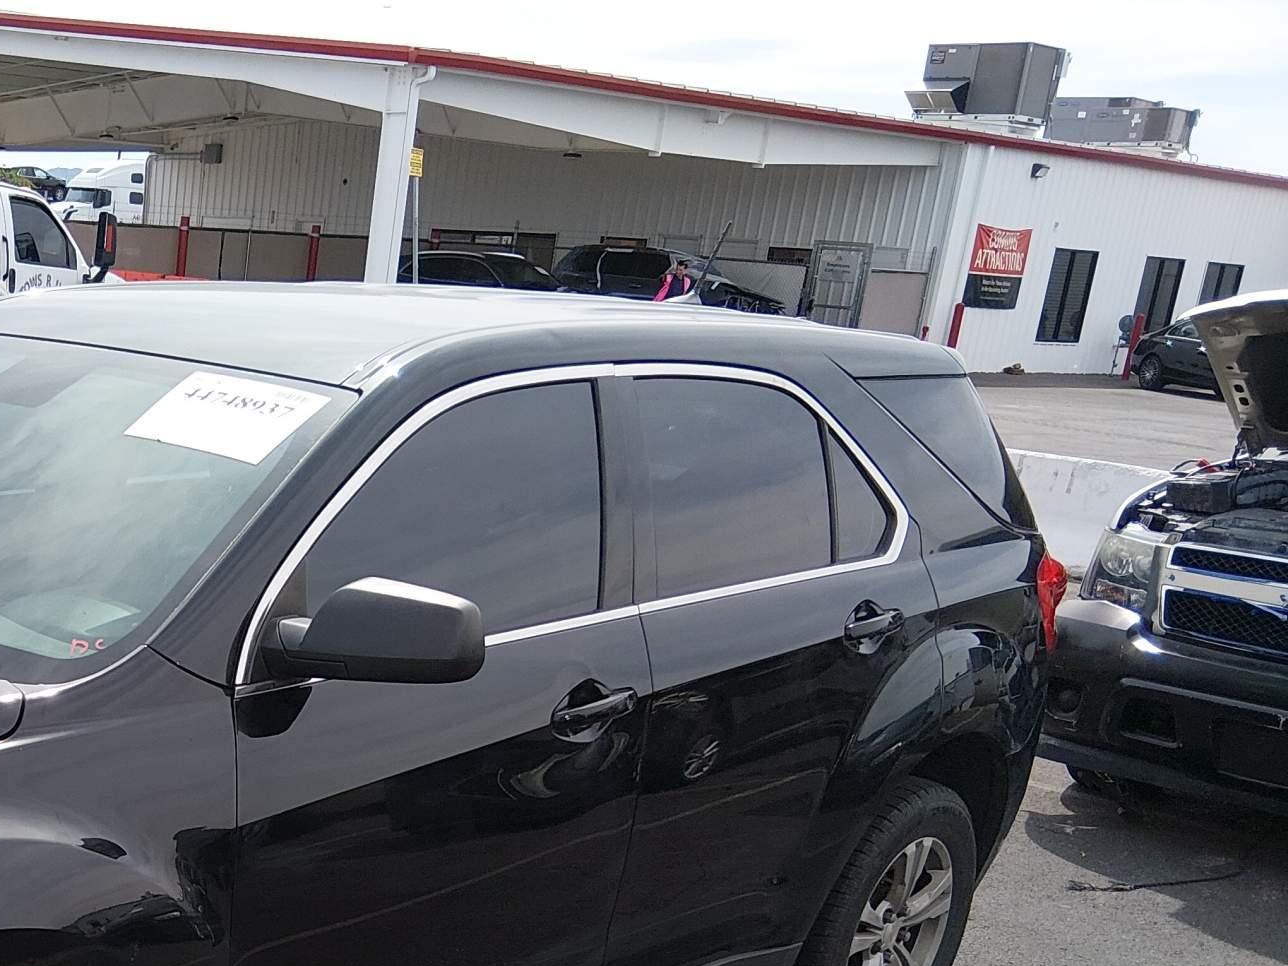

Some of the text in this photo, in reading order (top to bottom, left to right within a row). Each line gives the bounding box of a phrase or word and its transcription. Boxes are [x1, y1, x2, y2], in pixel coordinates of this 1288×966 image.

[988, 230, 1021, 250] COMING
[974, 248, 1025, 271] ATTRACTIONS
[46, 273, 52, 287] R
[184, 388, 295, 418] 44748937
